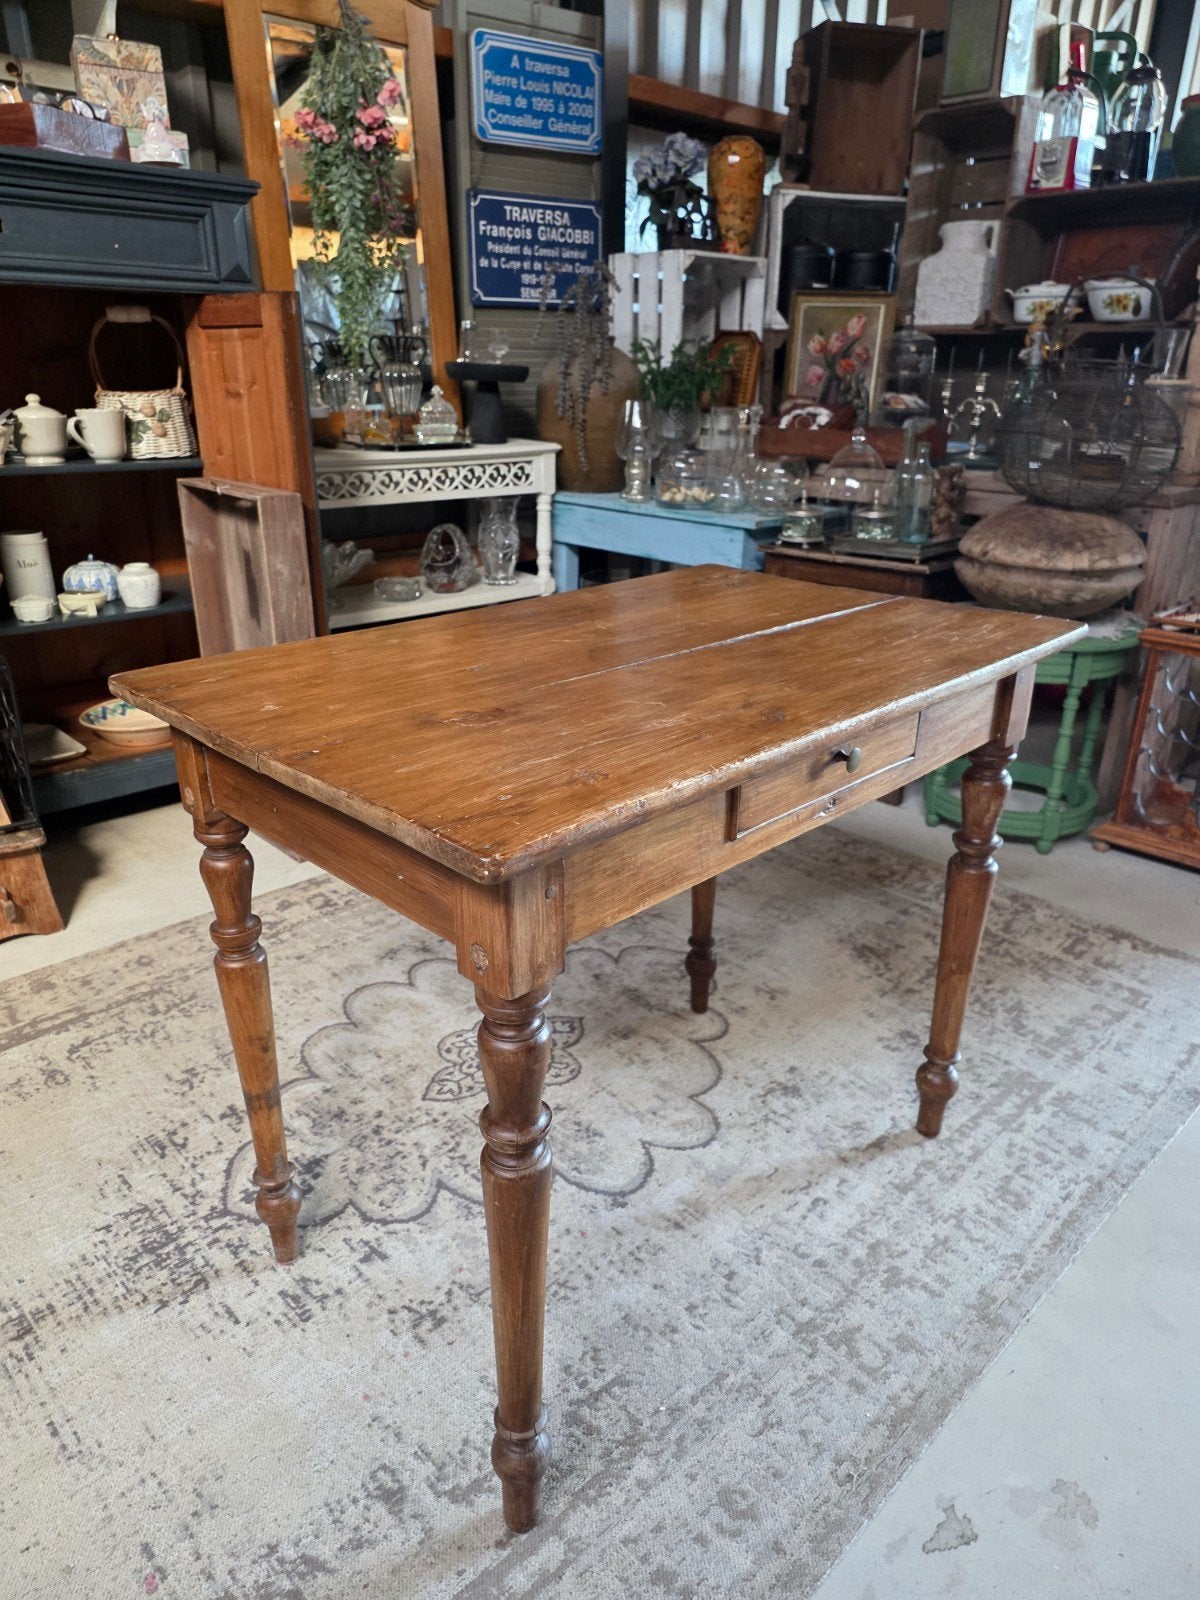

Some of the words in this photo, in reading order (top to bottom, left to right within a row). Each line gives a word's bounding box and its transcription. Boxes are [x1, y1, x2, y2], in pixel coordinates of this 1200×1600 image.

[510, 54, 520, 70] A
[524, 57, 570, 78] traversa
[484, 70, 518, 89] Pierre
[520, 76, 551, 94] Louis
[484, 88, 512, 107] Maire
[514, 94, 528, 109] de
[488, 108, 545, 130] Conseiller
[547, 117, 592, 136] Général
[504, 205, 571, 227] TRAVERSA
[479, 220, 533, 242] François
[537, 225, 595, 245] GIACOBBI
